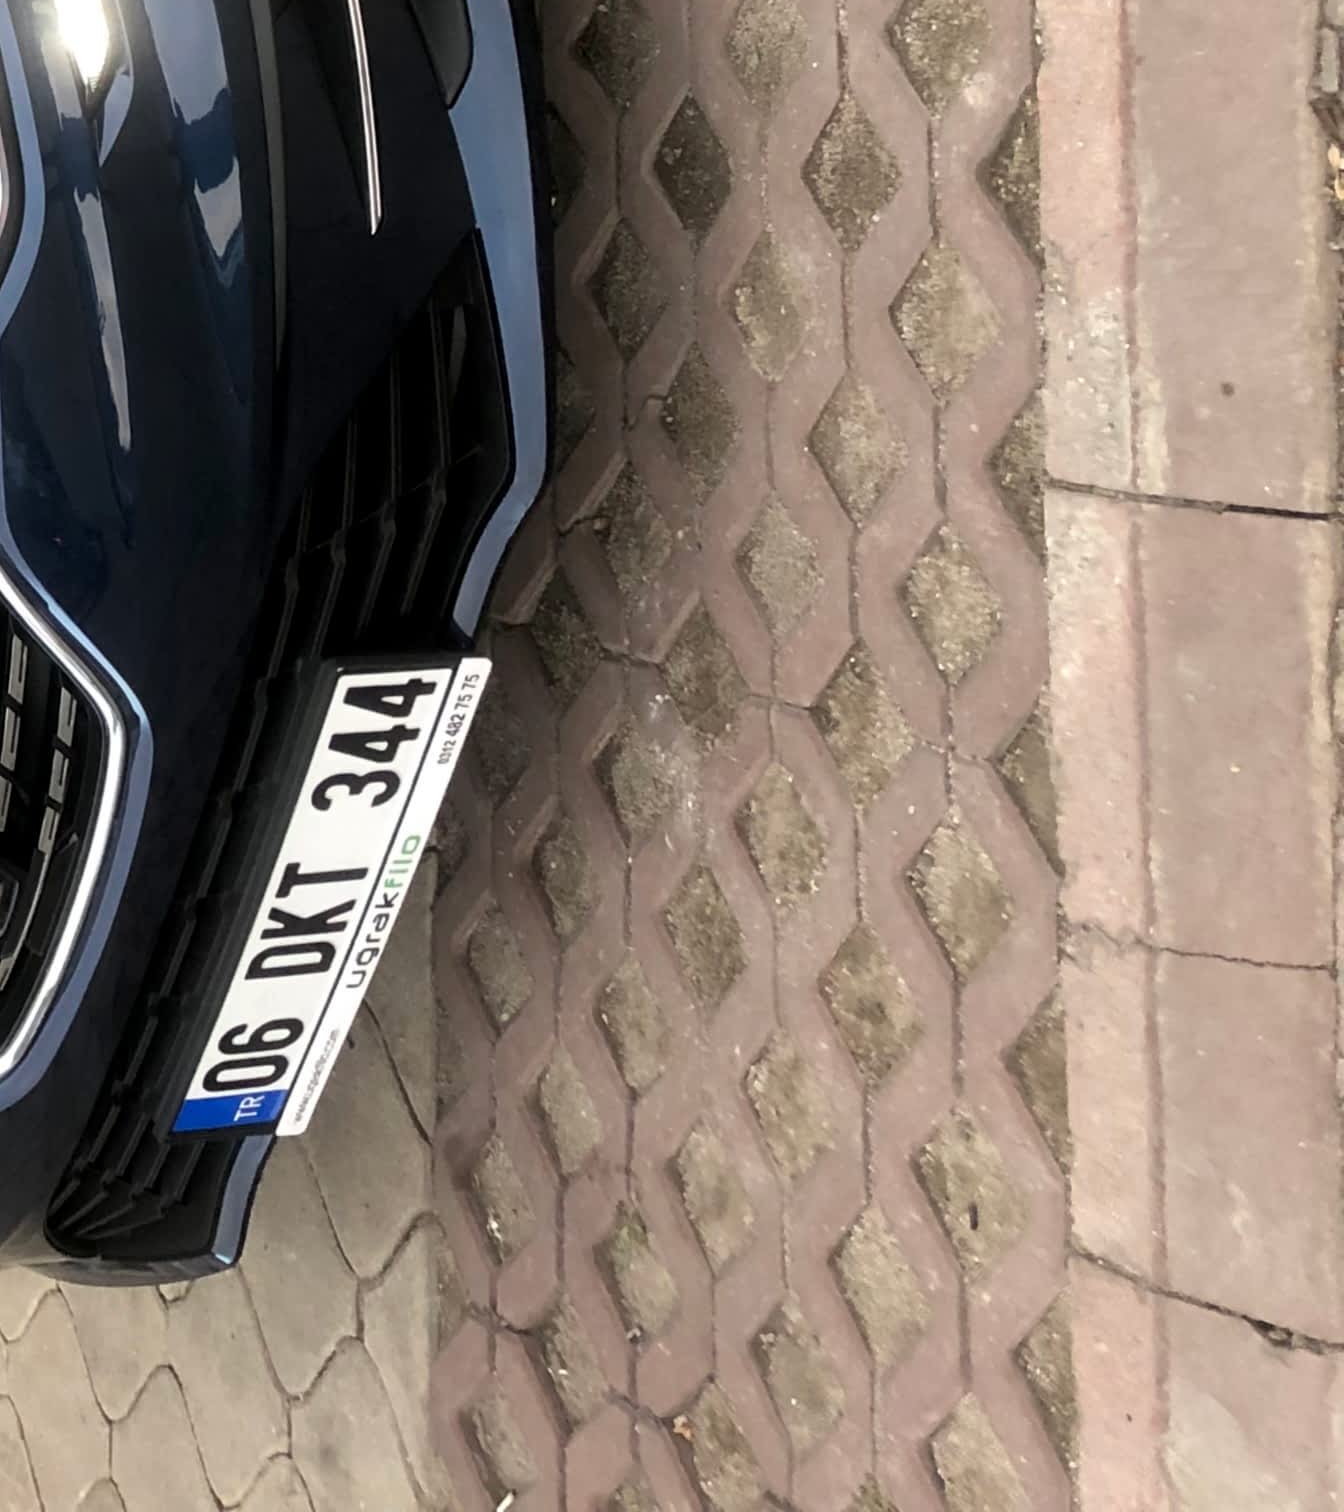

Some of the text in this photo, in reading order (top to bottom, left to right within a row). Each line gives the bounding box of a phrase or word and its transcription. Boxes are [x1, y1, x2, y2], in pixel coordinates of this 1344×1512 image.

[436, 674, 480, 765] 0312 482 75 75
[202, 678, 437, 1092] 06 DKT 344
[346, 835, 421, 989] ugrakfilo
[233, 1095, 265, 1121] TR
